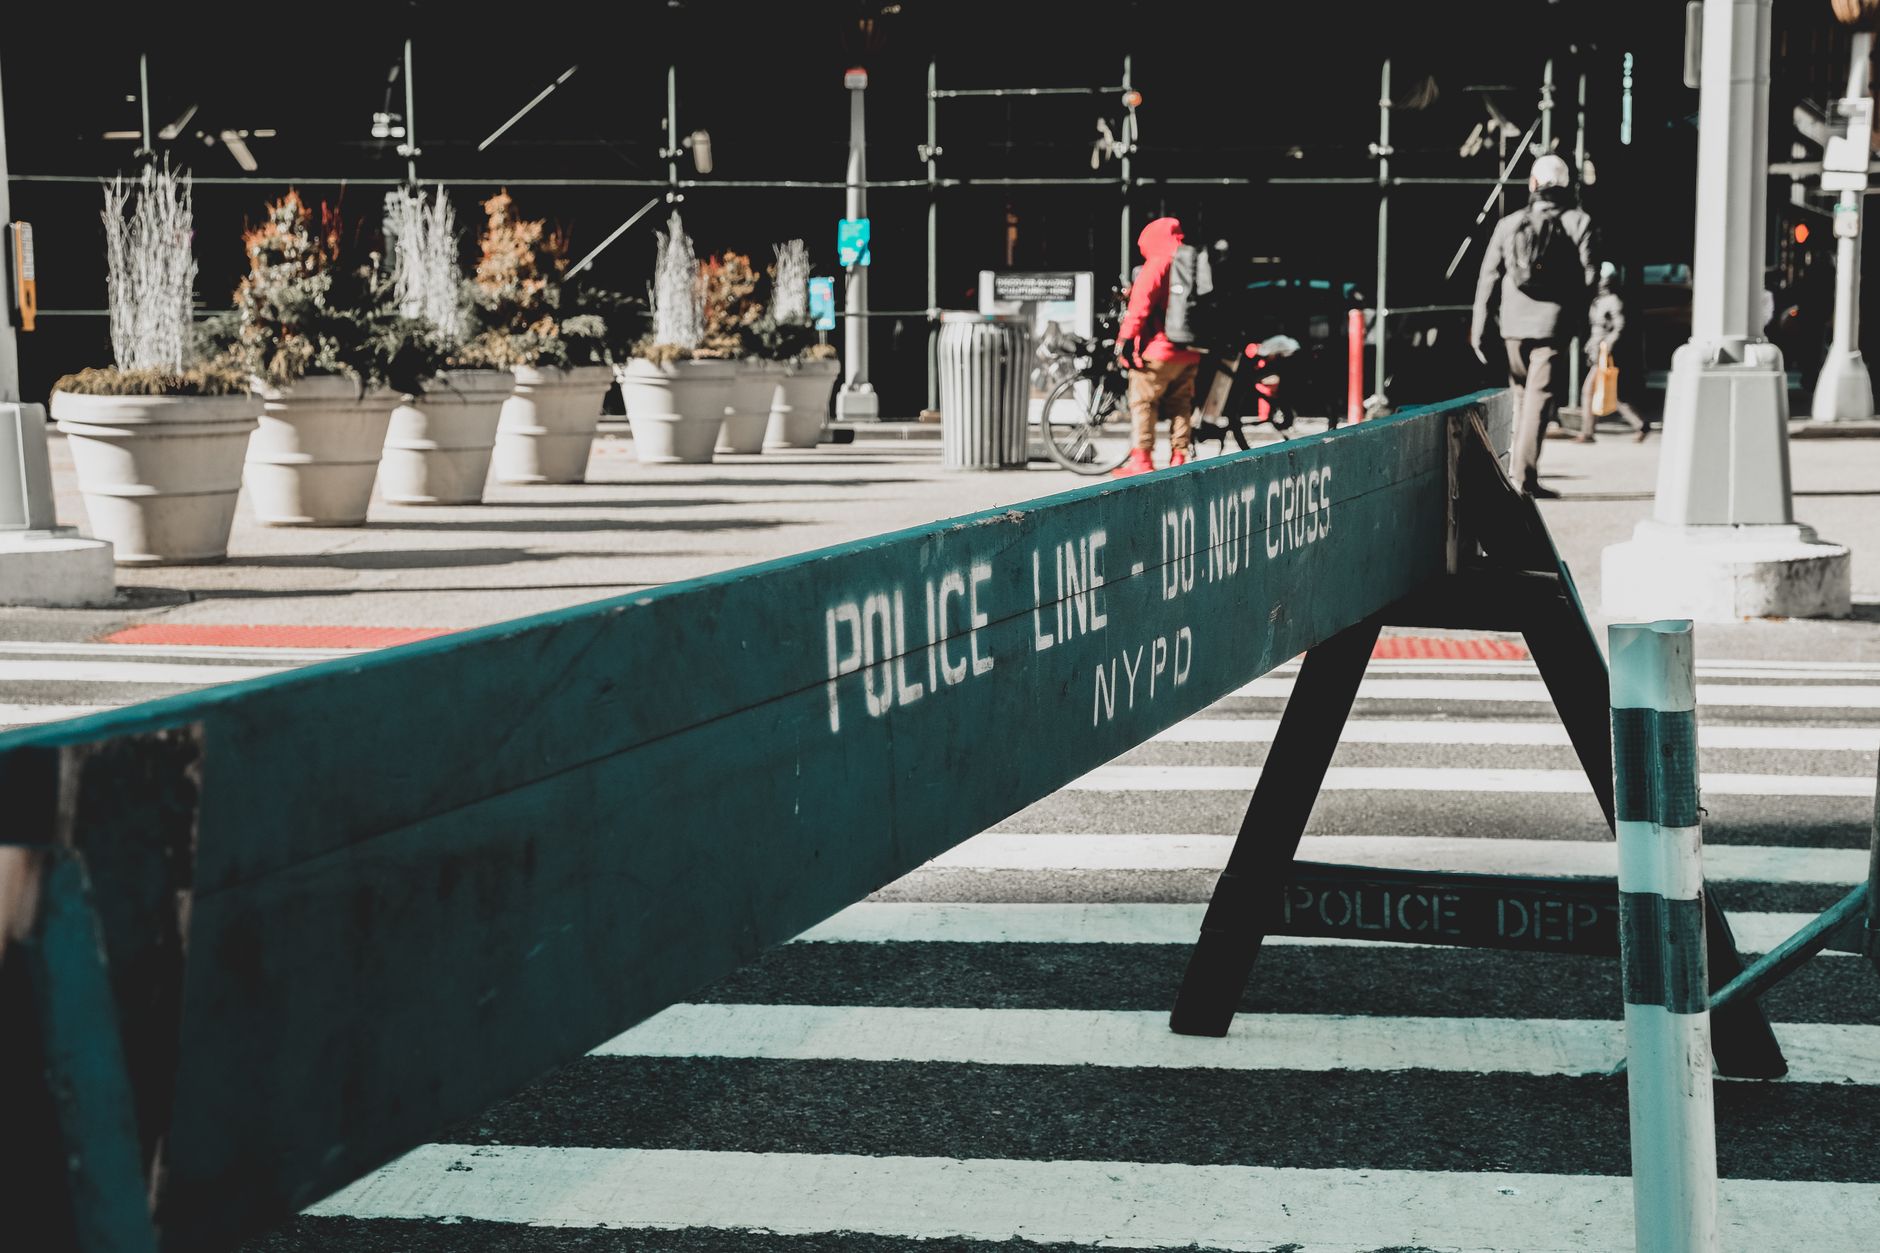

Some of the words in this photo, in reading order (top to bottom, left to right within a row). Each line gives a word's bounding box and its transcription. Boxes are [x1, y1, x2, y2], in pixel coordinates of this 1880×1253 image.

[826, 563, 994, 733] POLICE
[1033, 530, 1108, 651] LINE
[1162, 506, 1195, 600] DO
[1209, 485, 1256, 583] NOT
[1266, 466, 1332, 559] CROSS
[1094, 626, 1192, 727] NYPD
[1283, 885, 1461, 935] POLICE
